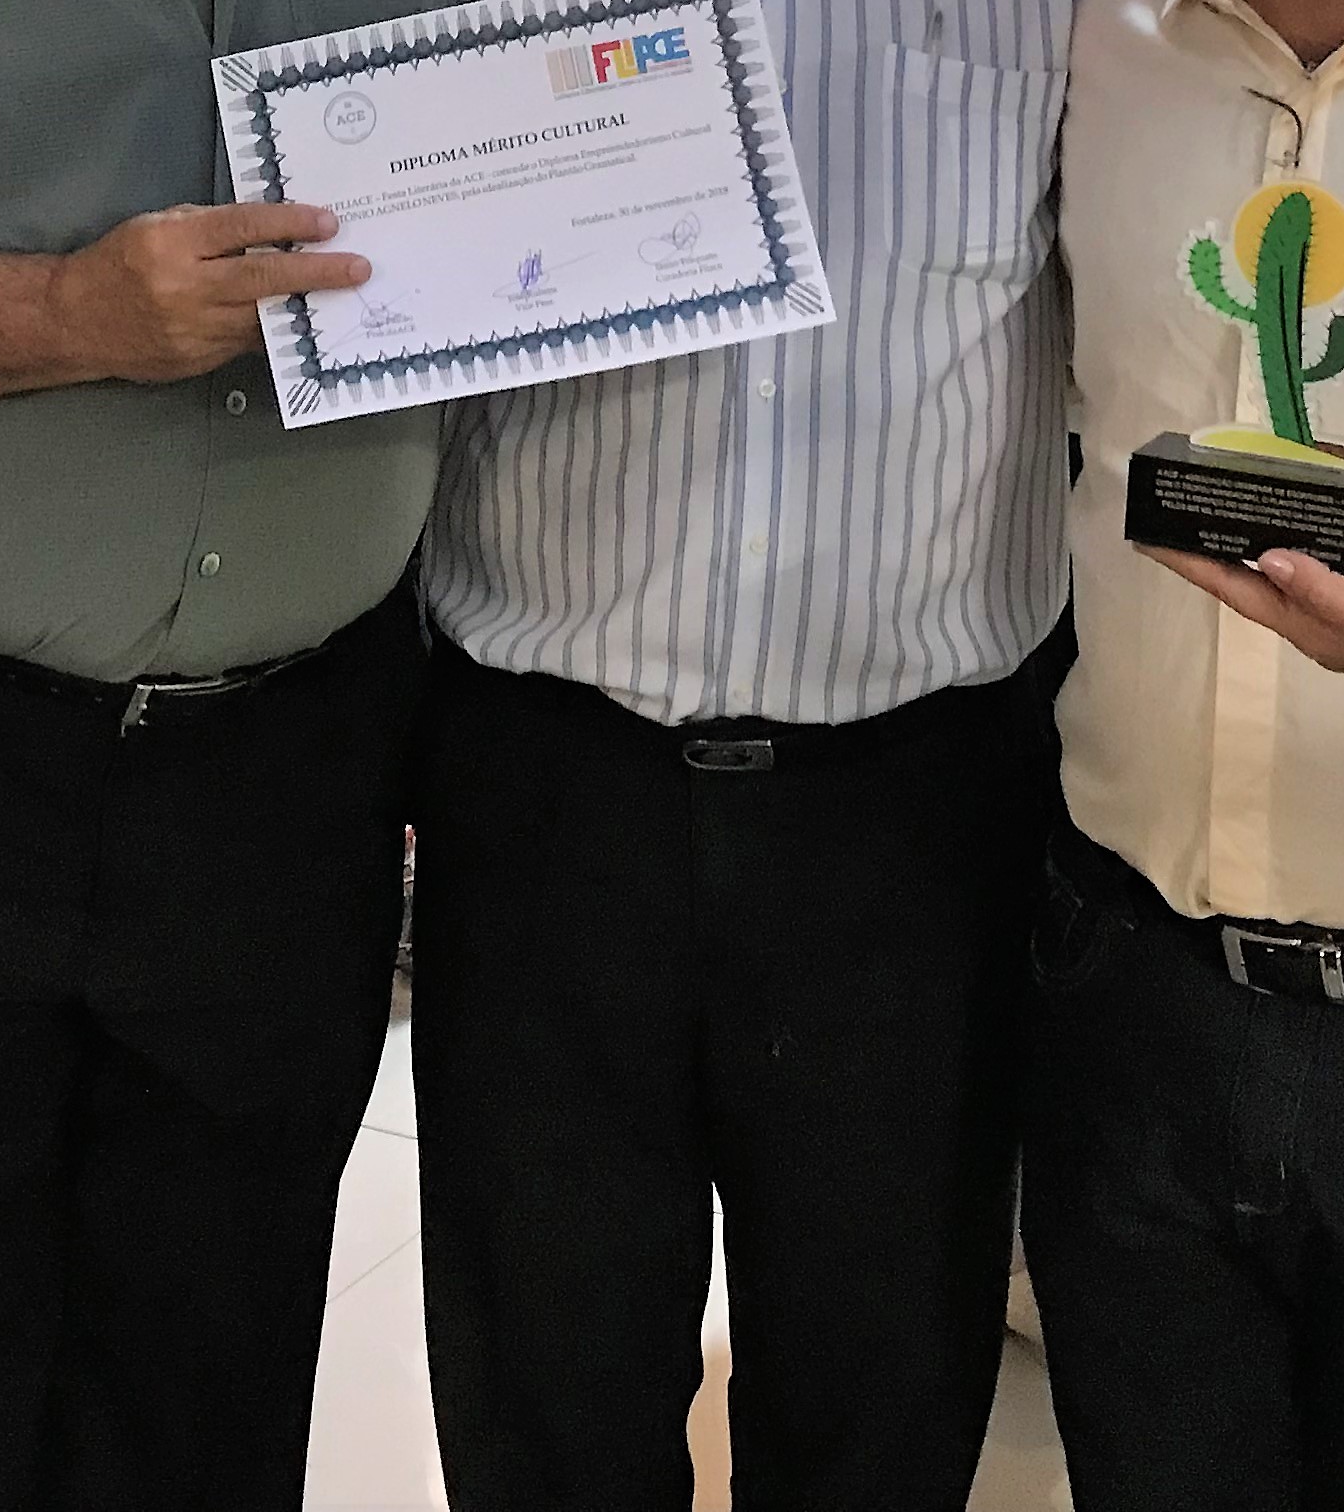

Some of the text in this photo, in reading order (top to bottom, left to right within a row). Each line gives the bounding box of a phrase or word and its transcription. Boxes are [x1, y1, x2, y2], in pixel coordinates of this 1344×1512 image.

[336, 110, 367, 126] ACE
[389, 113, 630, 174] DIPLOMA MÉRITO CULTURAL
[463, 171, 486, 186] ACE
[339, 208, 375, 224] TÔNIO
[376, 198, 422, 216] AGNELO
[644, 194, 693, 212] novembro
